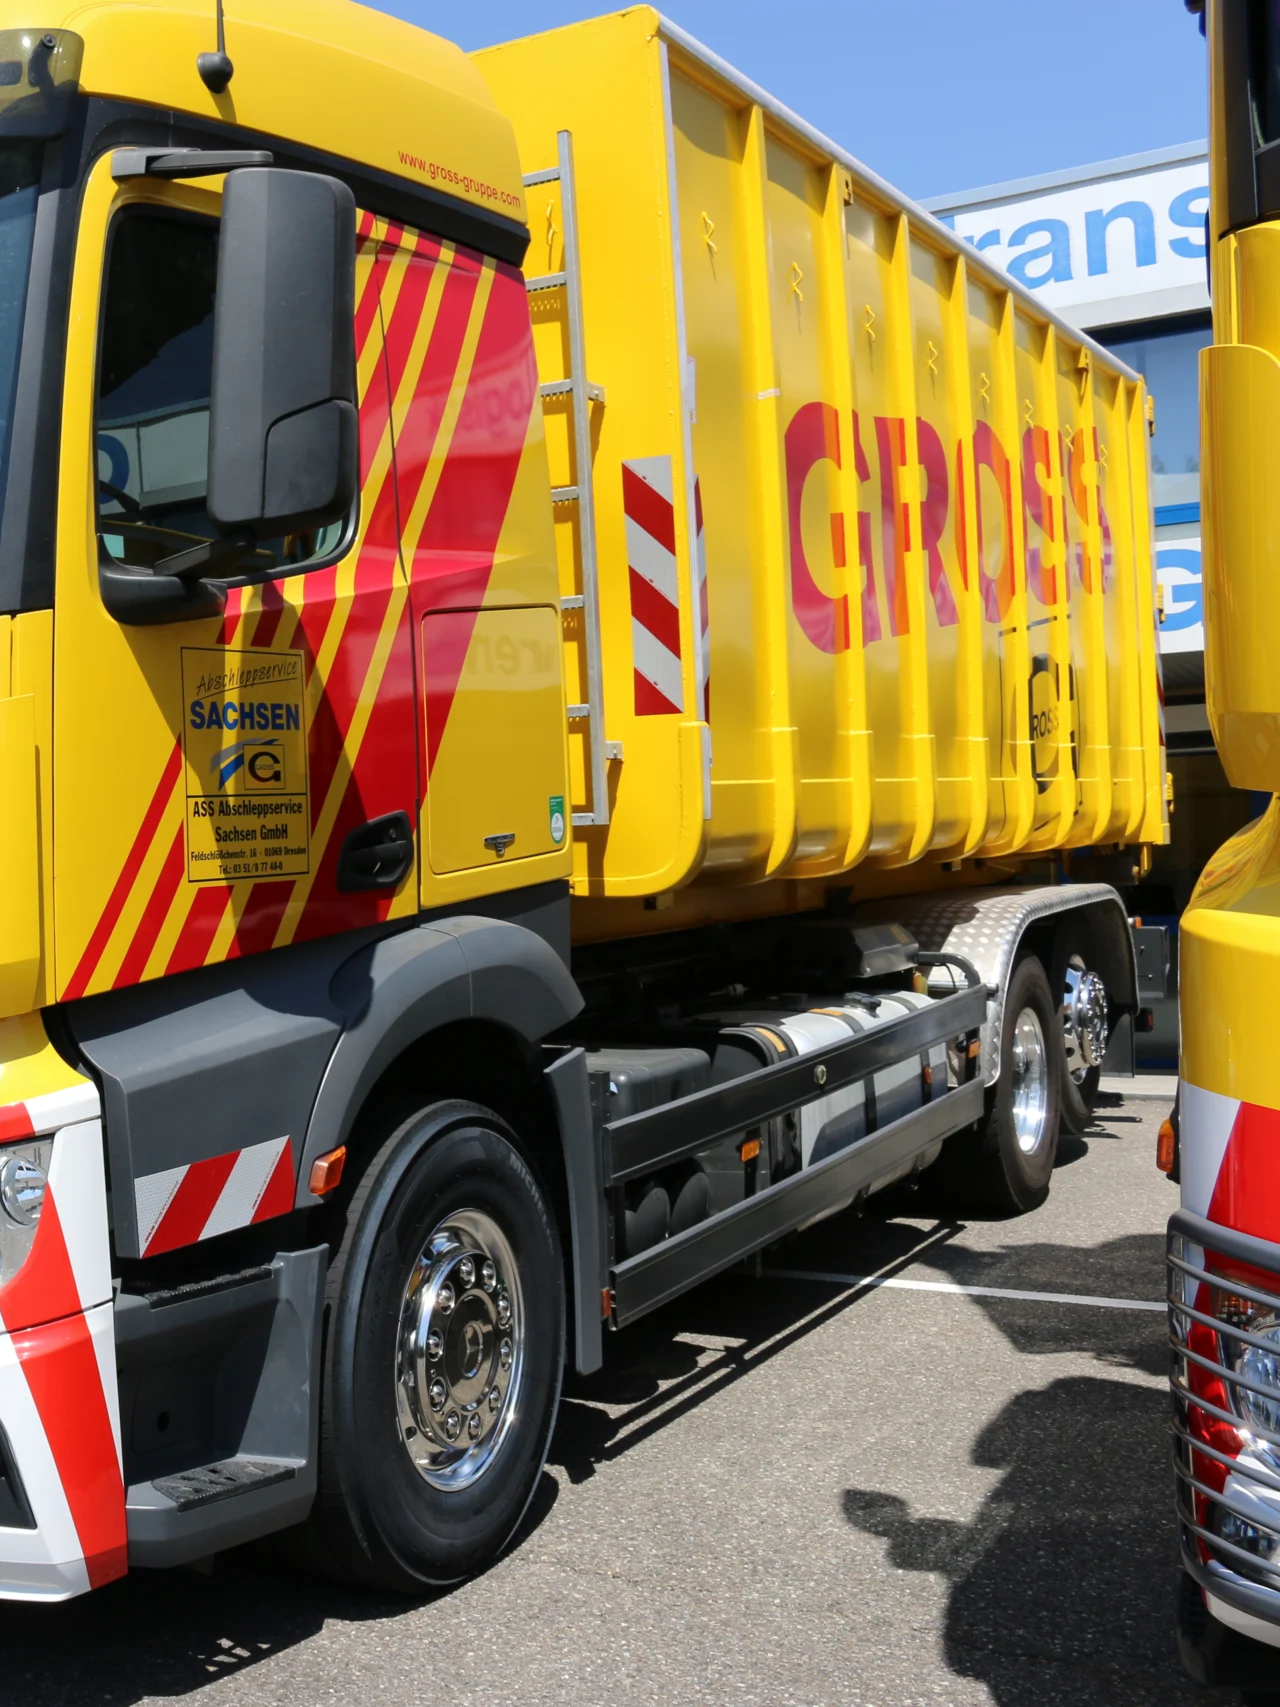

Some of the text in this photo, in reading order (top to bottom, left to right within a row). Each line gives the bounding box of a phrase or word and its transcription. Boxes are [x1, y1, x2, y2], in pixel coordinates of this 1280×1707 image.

[397, 150, 522, 209] www.gross-gruppe.com
[784, 401, 1112, 655] GROSS
[195, 659, 298, 697] Abschleppservice
[189, 699, 301, 731] SACHSEN
[193, 798, 303, 819] ASS Abschleppservice
[215, 823, 289, 843] Sachsen GmbH
[249, 848, 257, 858] 16
[264, 846, 283, 857] 01069
[283, 845, 307, 856] Dresden
[233, 863, 242, 874] 03
